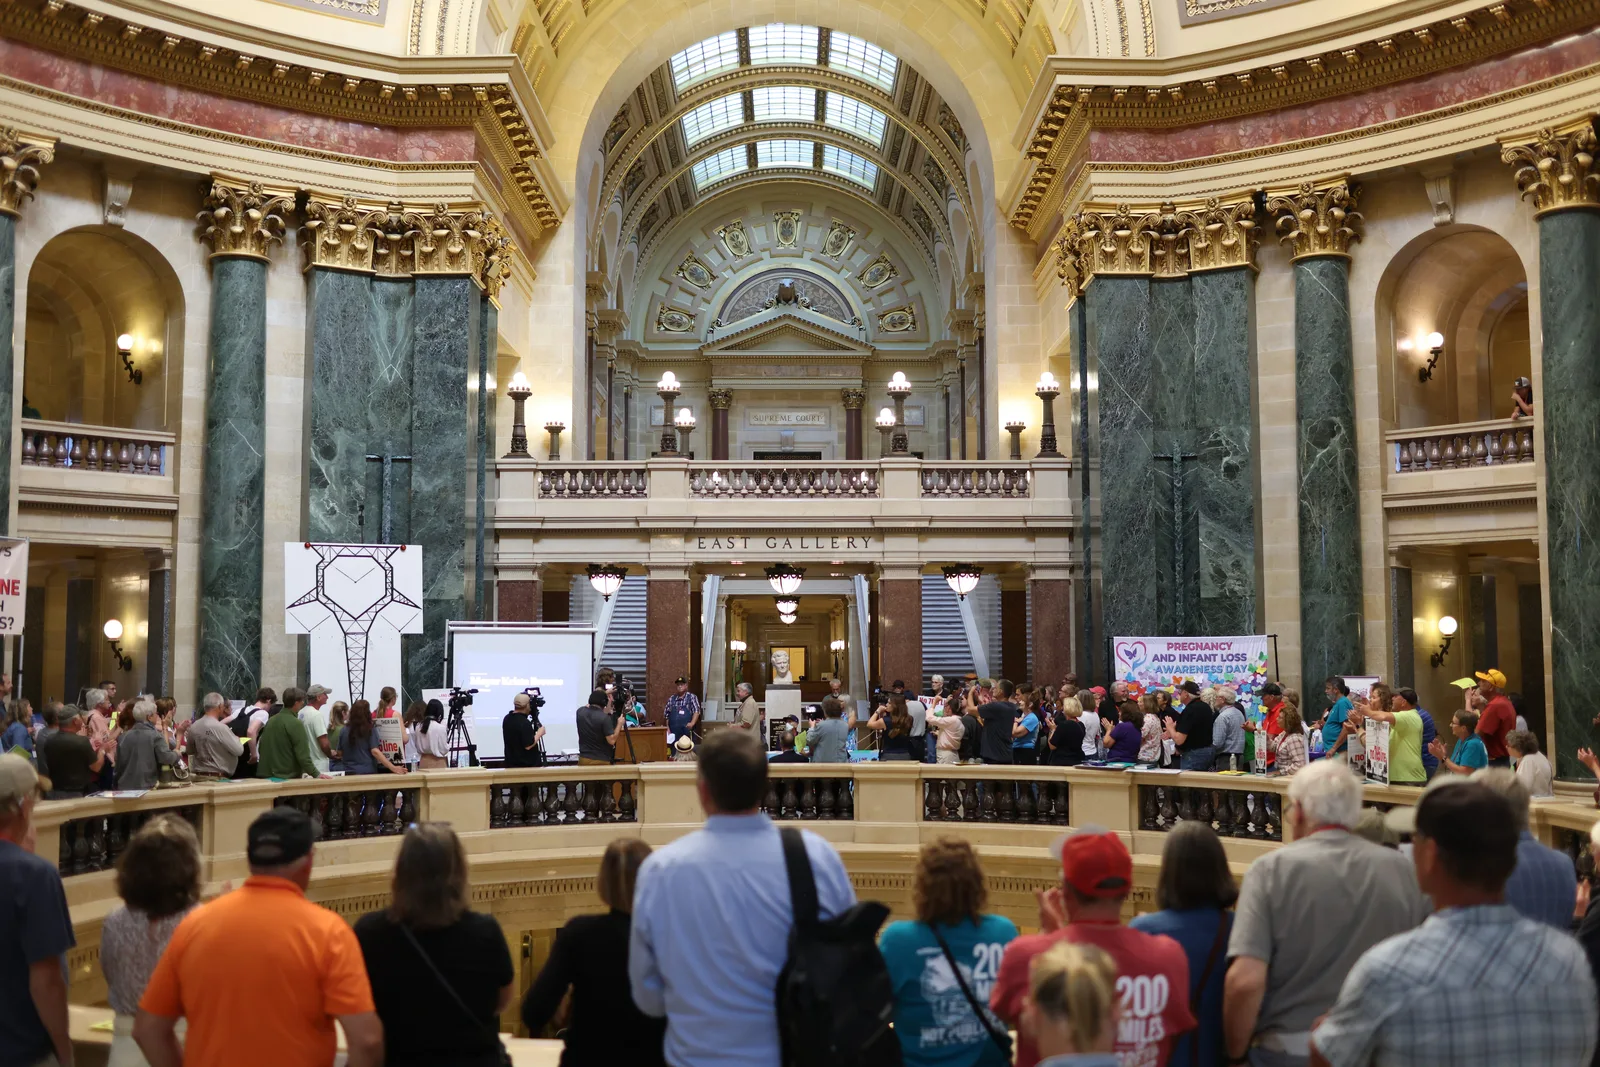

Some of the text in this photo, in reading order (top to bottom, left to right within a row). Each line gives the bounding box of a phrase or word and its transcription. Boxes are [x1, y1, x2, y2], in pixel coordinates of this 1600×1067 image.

[753, 414, 824, 422] SUPREME COURT
[697, 536, 872, 549] EAST GALLERY
[1167, 641, 1233, 651] PREGNANCY
[1152, 653, 1248, 662] AND INFANT LOSS
[1155, 664, 1248, 674] AWARENESS DAY
[1115, 973, 1169, 1018] 200
[1117, 1016, 1166, 1043] MILES
